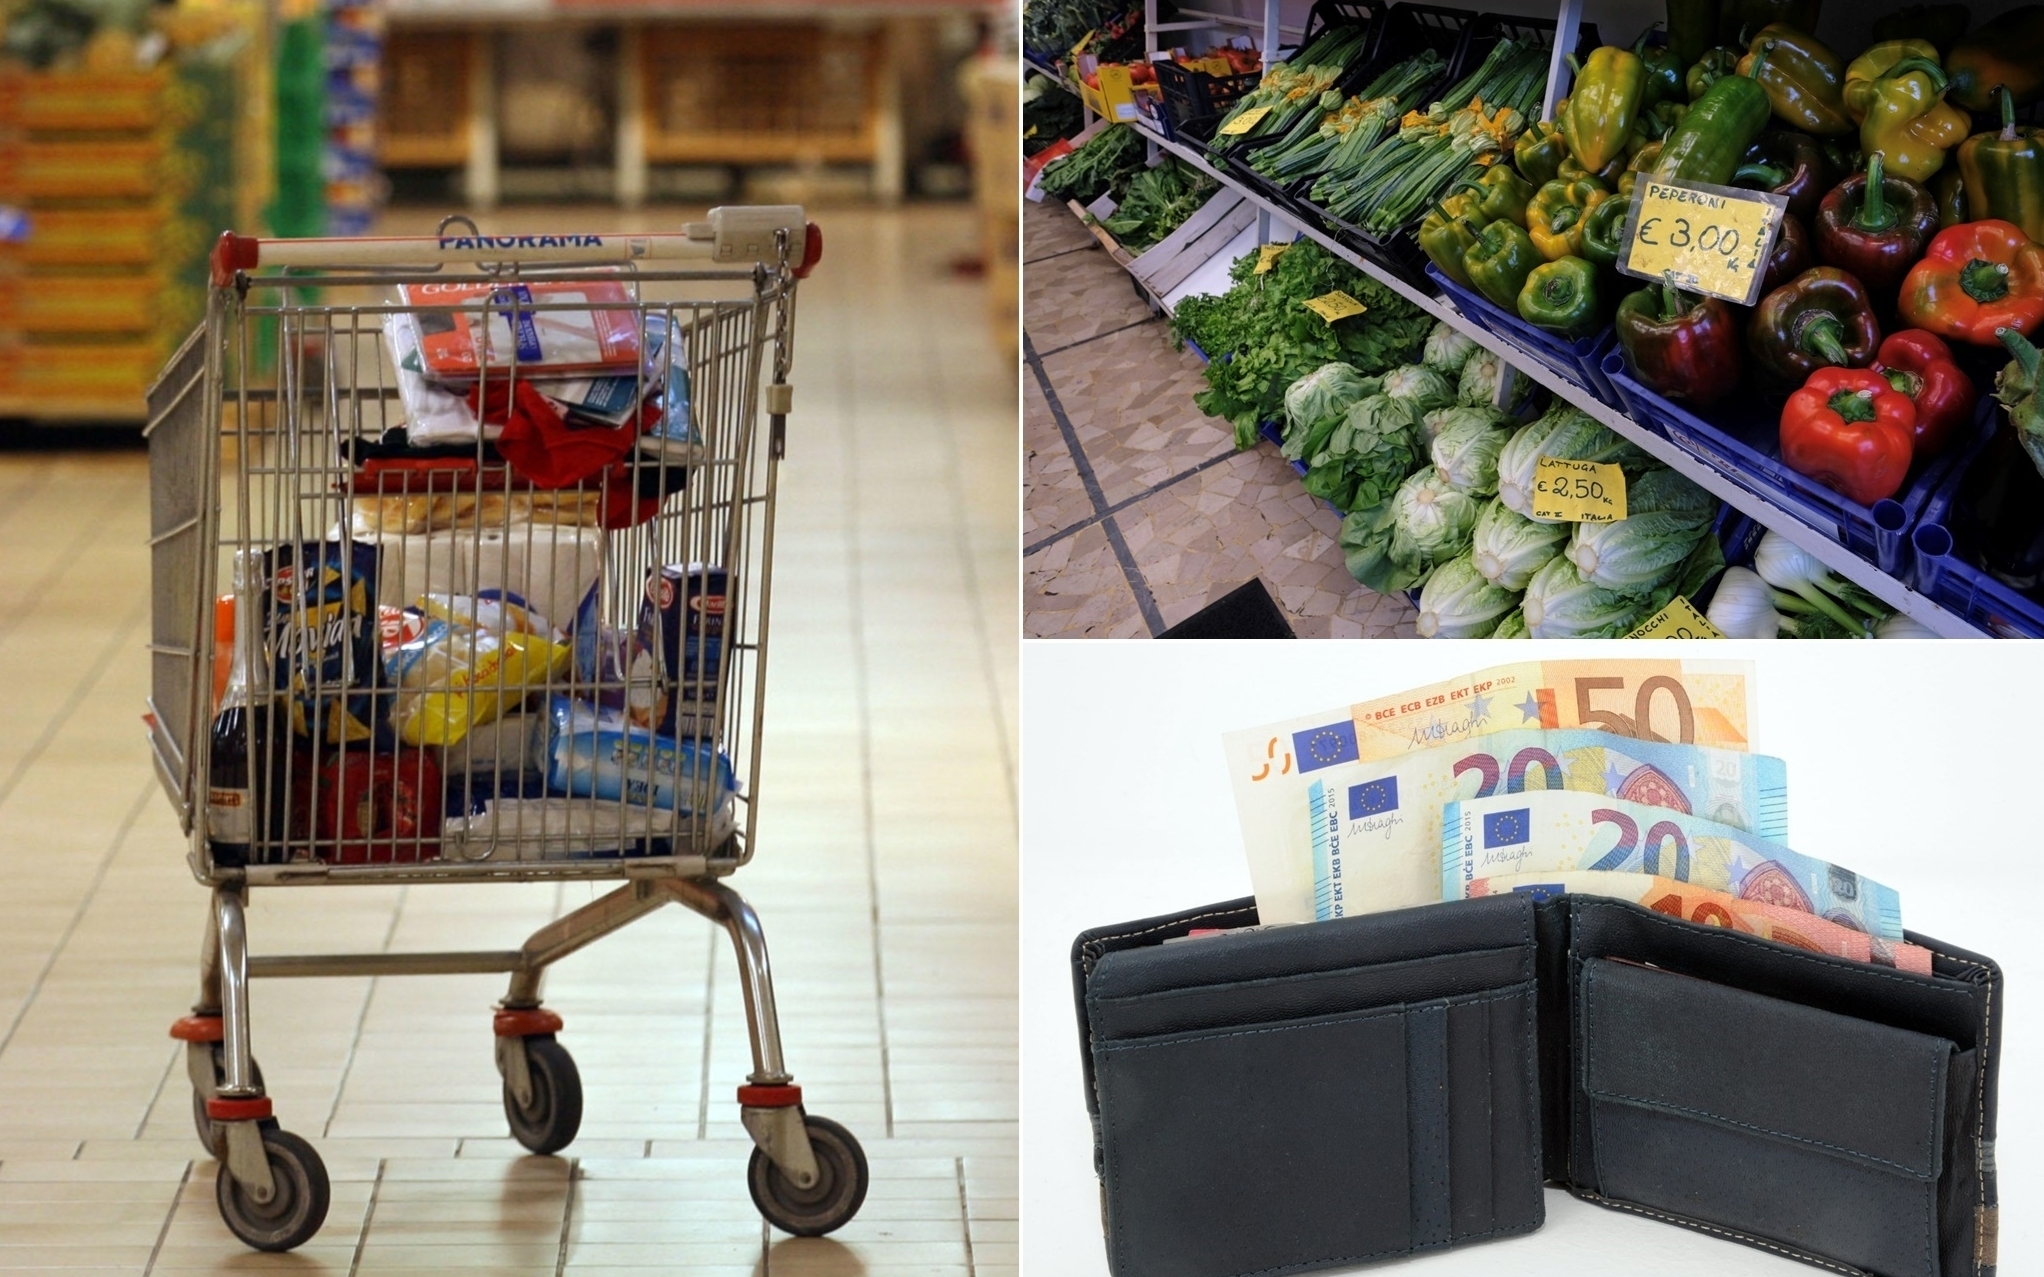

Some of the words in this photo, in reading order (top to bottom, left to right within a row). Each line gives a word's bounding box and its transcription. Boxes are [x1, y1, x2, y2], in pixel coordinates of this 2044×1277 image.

[1649, 185, 1726, 209] PEPERONI
[438, 235, 603, 249] PANORAMA
[1639, 217, 1662, 245] €
[1669, 217, 1740, 256] 3,00
[1540, 458, 1597, 474] LATTUGA
[1537, 480, 1548, 492] €
[1552, 476, 1604, 500] 2,50
[1581, 512, 1613, 521] ITALIA
[1375, 708, 1396, 720] BCE
[1400, 701, 1421, 714] ECB
[1425, 694, 1445, 708] EZB
[1450, 687, 1470, 701] EKT
[1473, 680, 1493, 694] EKP
[1496, 676, 1516, 685] 2002
[1574, 675, 1695, 745] 50
[1452, 747, 1565, 799] 20
[1327, 788, 1336, 808] 2015
[1329, 811, 1338, 833] EBC
[1464, 810, 1472, 831] 2015
[1464, 835, 1473, 857] EBC
[1587, 808, 1690, 883] 20
[1332, 858, 1341, 880] EKB
[1333, 882, 1343, 902] EKT
[1334, 903, 1344, 919] KP
